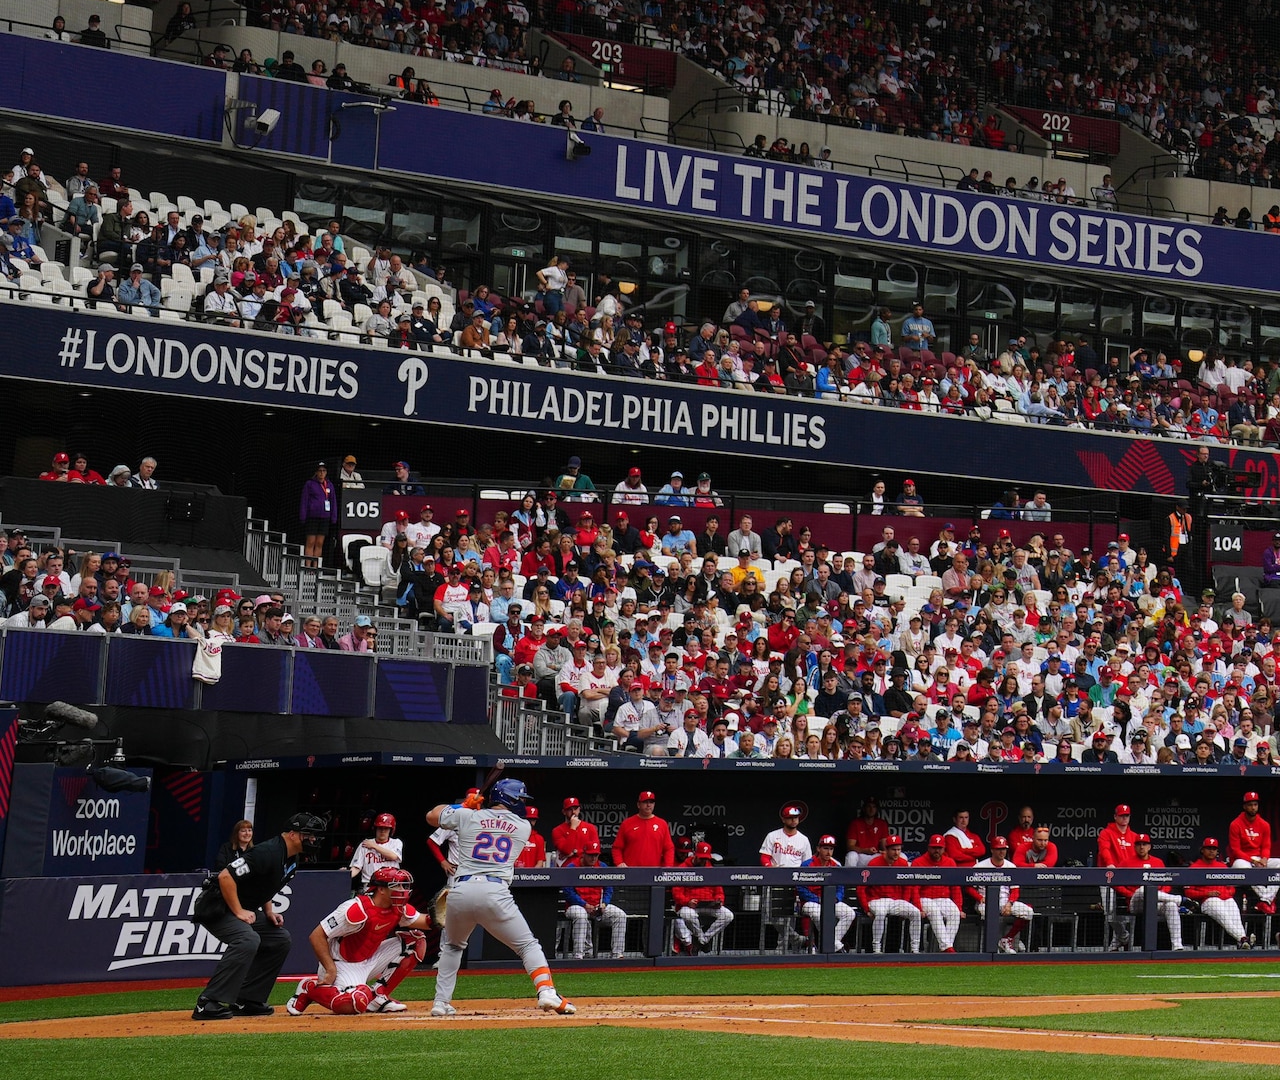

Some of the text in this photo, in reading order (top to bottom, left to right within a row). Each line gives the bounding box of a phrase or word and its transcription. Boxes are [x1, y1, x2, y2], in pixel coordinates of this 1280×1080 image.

[591, 42, 623, 64] 203
[1042, 113, 1071, 132] 202
[615, 143, 1204, 278] LIVE THE LONDON SERIES
[58, 327, 359, 400] #LONDONSERIES
[467, 375, 827, 450] PHILADELPHIA PHILLIES
[344, 500, 379, 519] 105
[1213, 535, 1240, 552] 104
[75, 798, 120, 819] zoom
[683, 804, 726, 817] zoom
[1057, 807, 1097, 818] zoom
[480, 819, 518, 834] STEWART
[1145, 814, 1200, 826] LONDON
[1150, 827, 1194, 839] SERIES
[52, 829, 136, 861] Workplace
[472, 831, 513, 863] 29
[774, 841, 803, 858] Phillies
[230, 857, 250, 877] 85
[68, 884, 292, 920] MATTS
